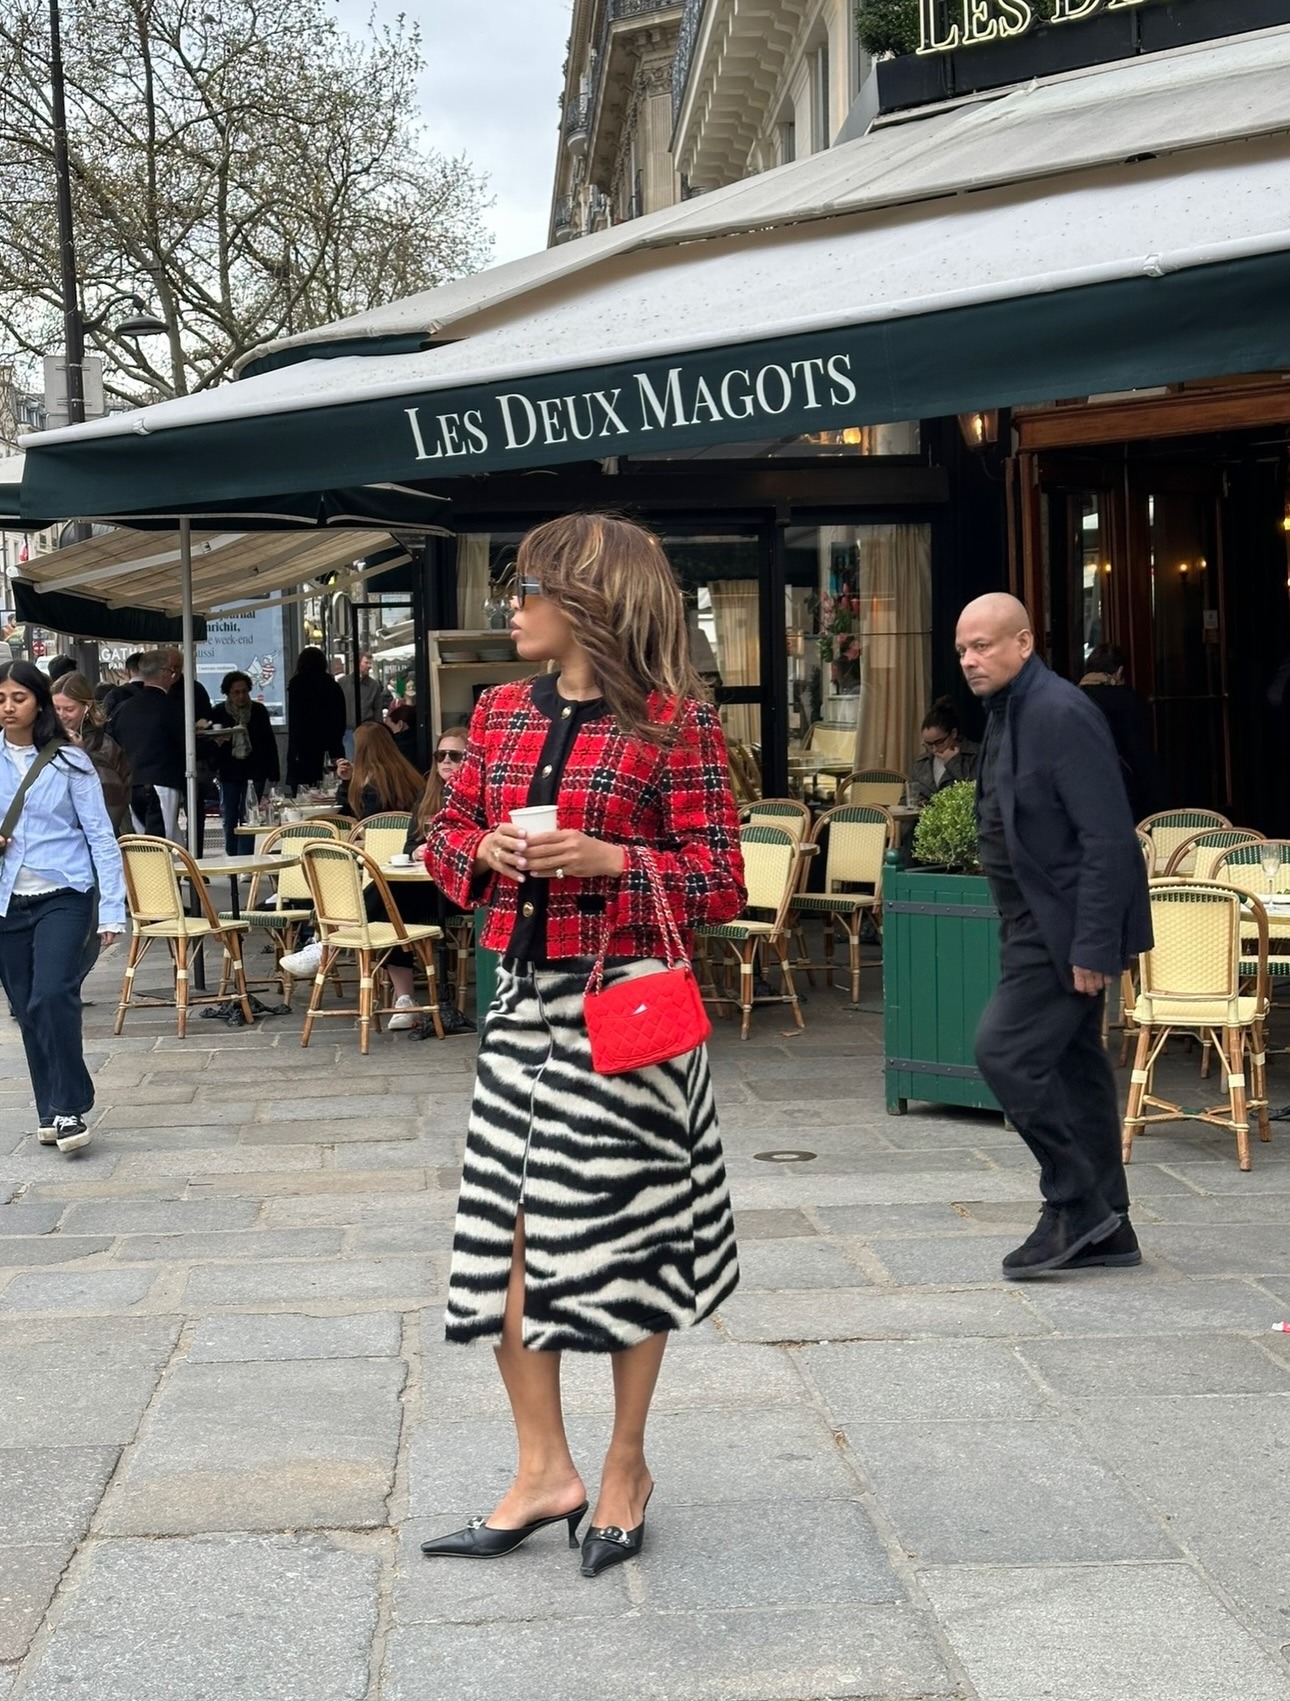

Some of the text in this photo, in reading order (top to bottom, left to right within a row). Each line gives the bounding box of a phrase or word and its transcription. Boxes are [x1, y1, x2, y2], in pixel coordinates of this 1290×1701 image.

[915, 0, 1031, 54] LES
[404, 354, 857, 460] LES DEUX MAGOTS
[206, 622, 240, 632] nrichit,
[214, 634, 254, 645] week-end
[99, 647, 146, 661] GATH
[196, 648, 215, 658] ussi
